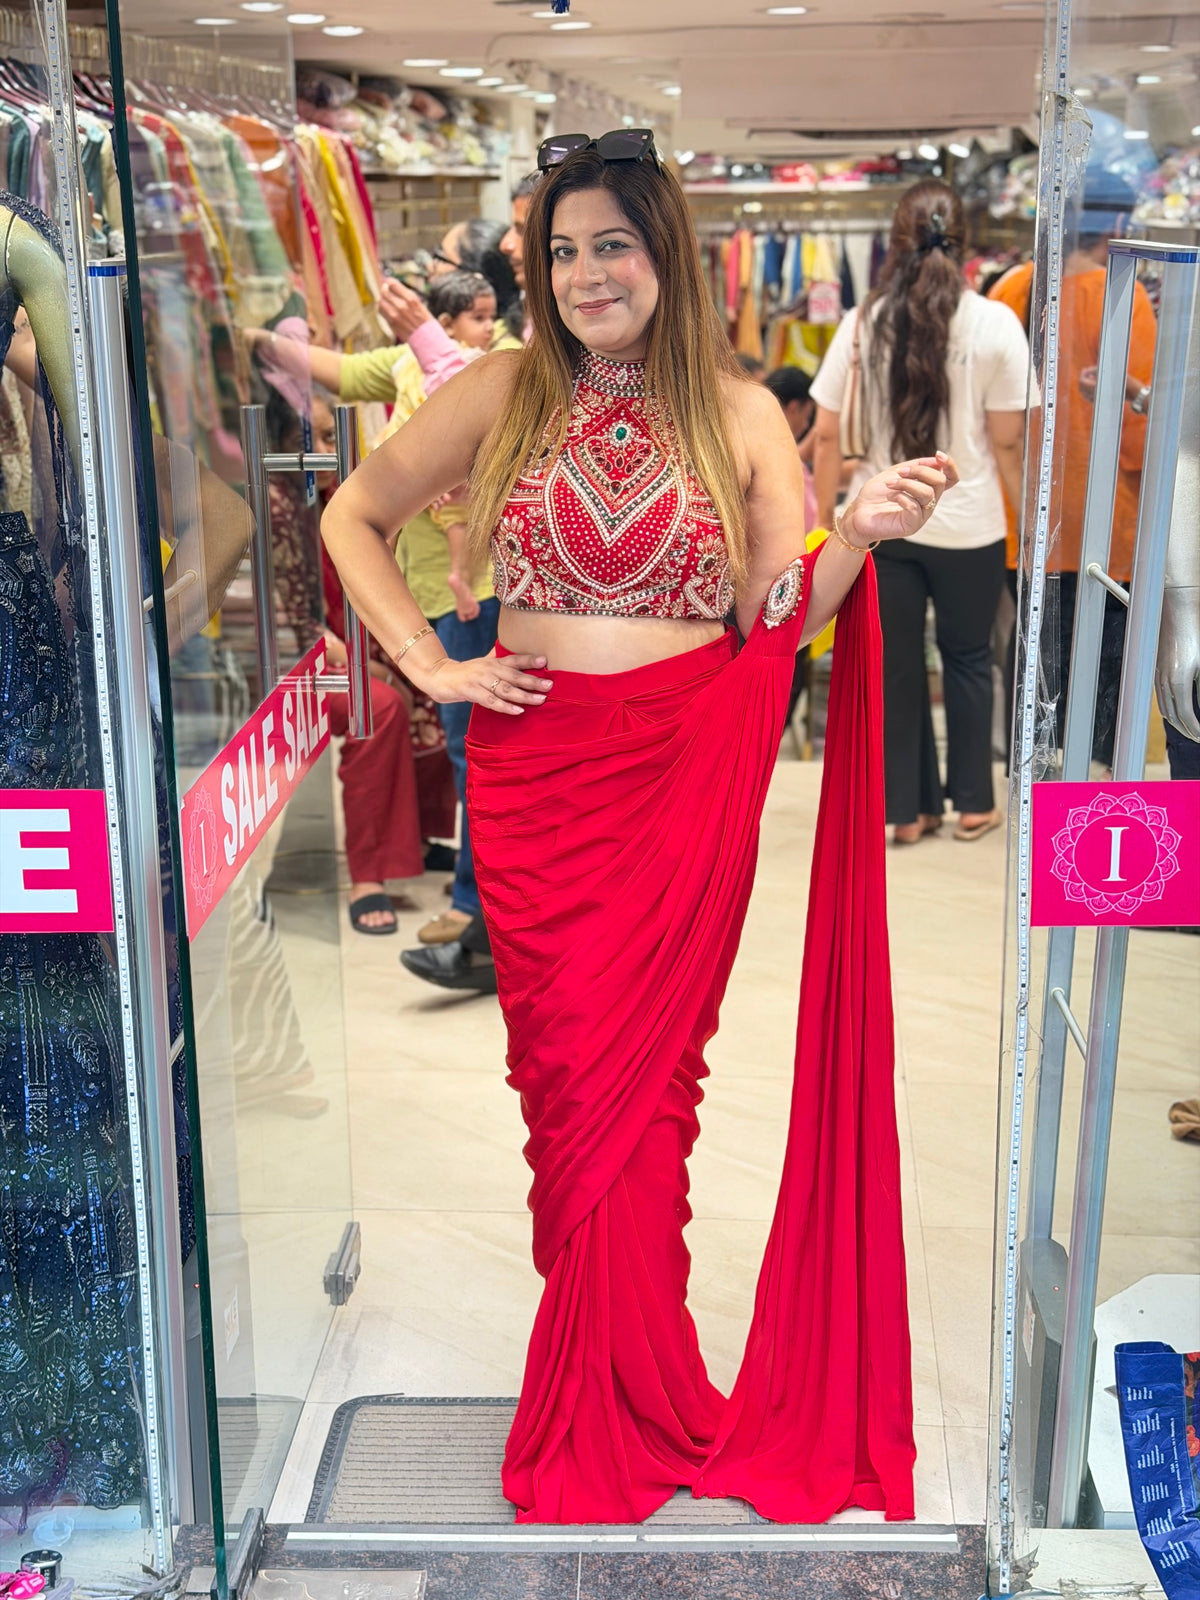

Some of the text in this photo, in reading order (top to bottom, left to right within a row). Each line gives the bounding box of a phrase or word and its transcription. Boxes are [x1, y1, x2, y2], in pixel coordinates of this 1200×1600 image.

[221, 711, 279, 866] SALE
[282, 651, 329, 782] SALE
[1101, 826, 1130, 882] I
